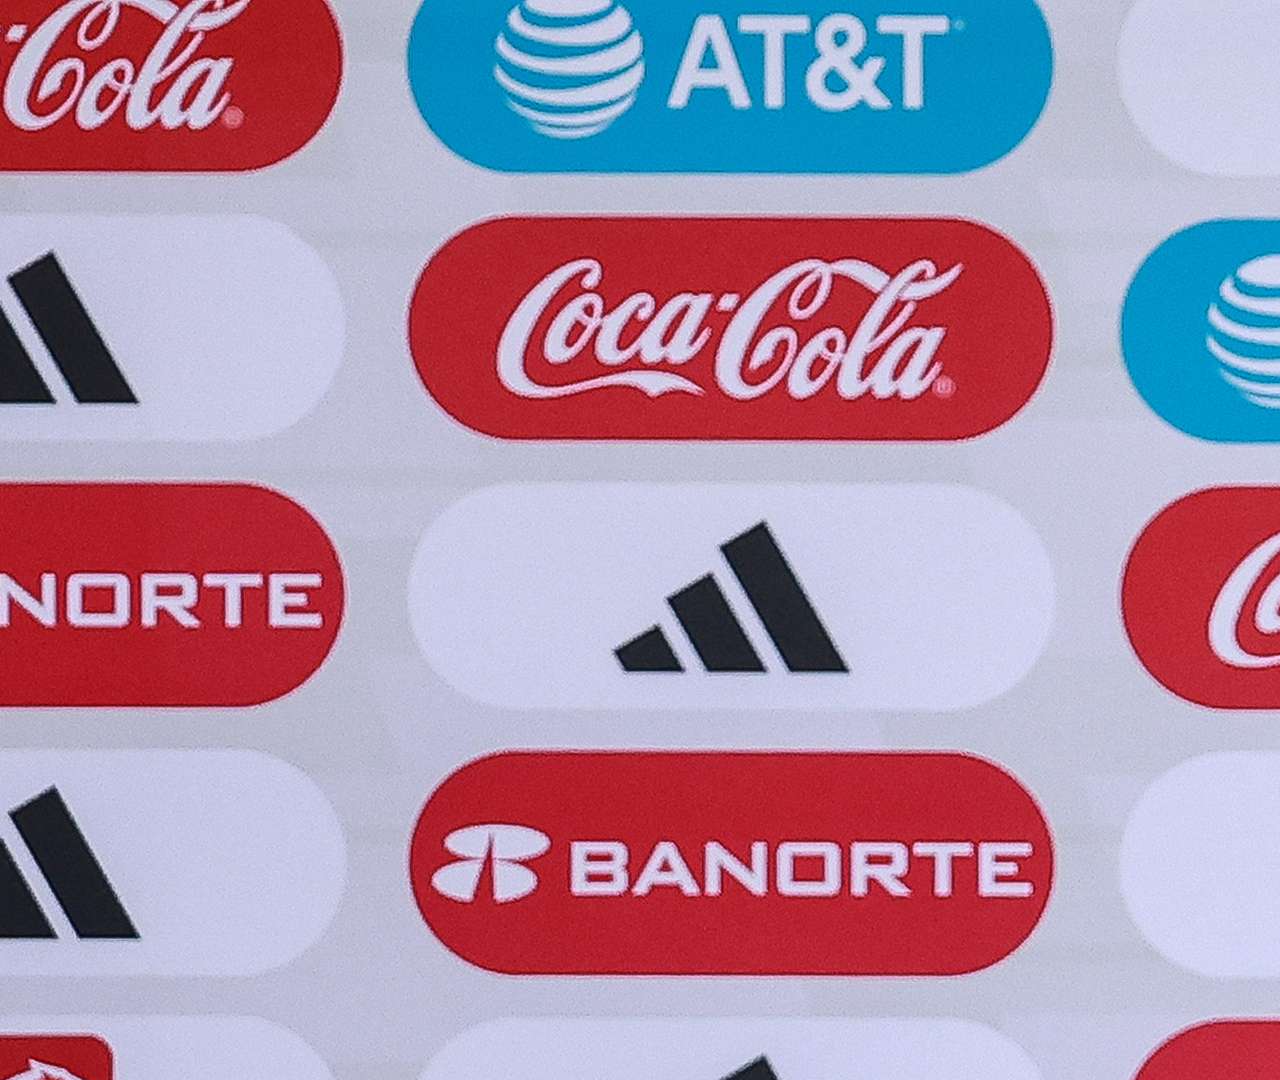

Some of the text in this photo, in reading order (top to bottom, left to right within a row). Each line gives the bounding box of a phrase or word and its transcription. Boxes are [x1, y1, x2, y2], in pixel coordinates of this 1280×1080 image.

[668, 14, 951, 110] AT&T
[497, 258, 961, 400] Coca-Cola
[570, 840, 1034, 897] BANORTE
